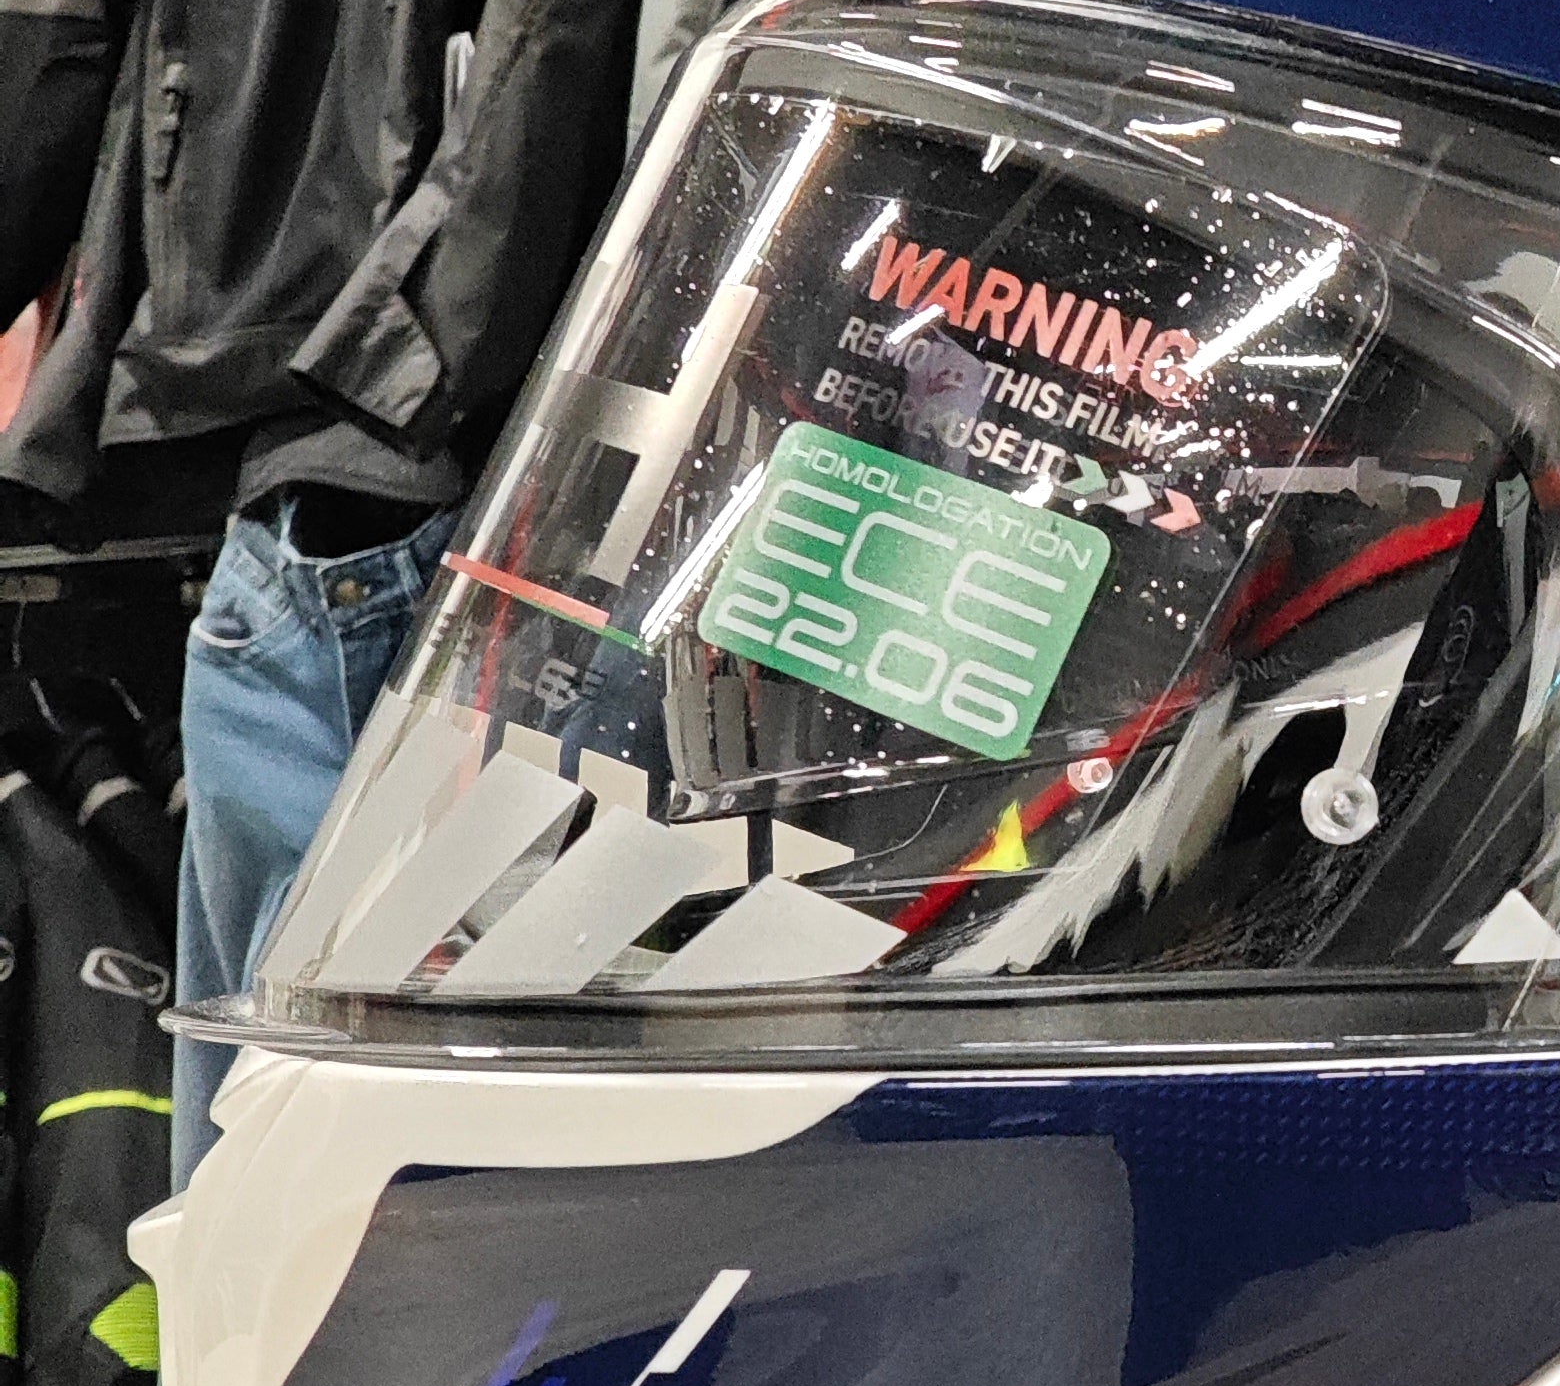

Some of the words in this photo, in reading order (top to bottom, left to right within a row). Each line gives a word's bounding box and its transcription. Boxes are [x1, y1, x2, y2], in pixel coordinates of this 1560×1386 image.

[868, 235, 1203, 408] WARNING
[980, 360, 1065, 420] THIS
[1064, 392, 1165, 458] FILM
[752, 478, 1068, 659] ECE
[788, 441, 1093, 571] HOMOLOGATION
[715, 570, 1035, 738] 22.06
